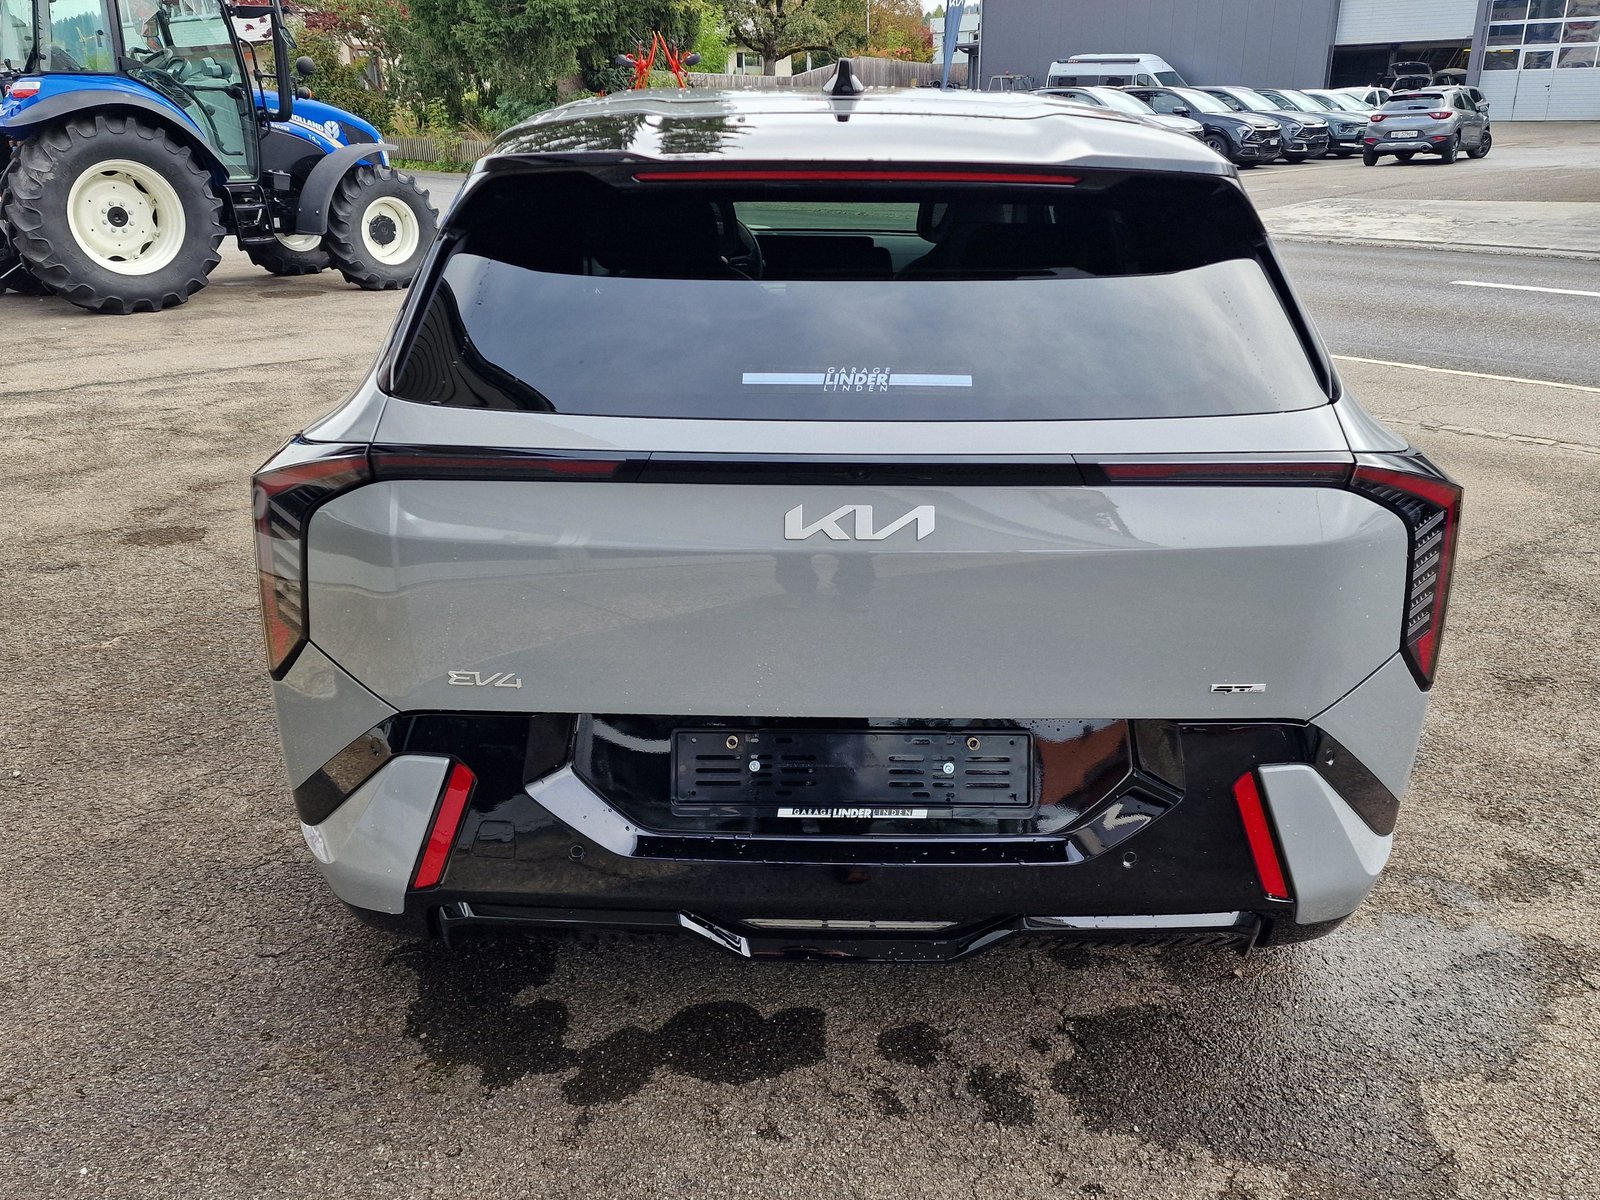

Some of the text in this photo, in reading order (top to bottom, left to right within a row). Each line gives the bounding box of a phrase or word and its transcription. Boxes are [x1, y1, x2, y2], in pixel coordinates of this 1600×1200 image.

[824, 373, 889, 386] LINDER
[823, 384, 888, 392] LINDEN
[784, 503, 935, 541] KIA
[447, 670, 522, 689] EV4
[793, 808, 832, 816] GARAGE
[832, 808, 872, 818] LINDER
